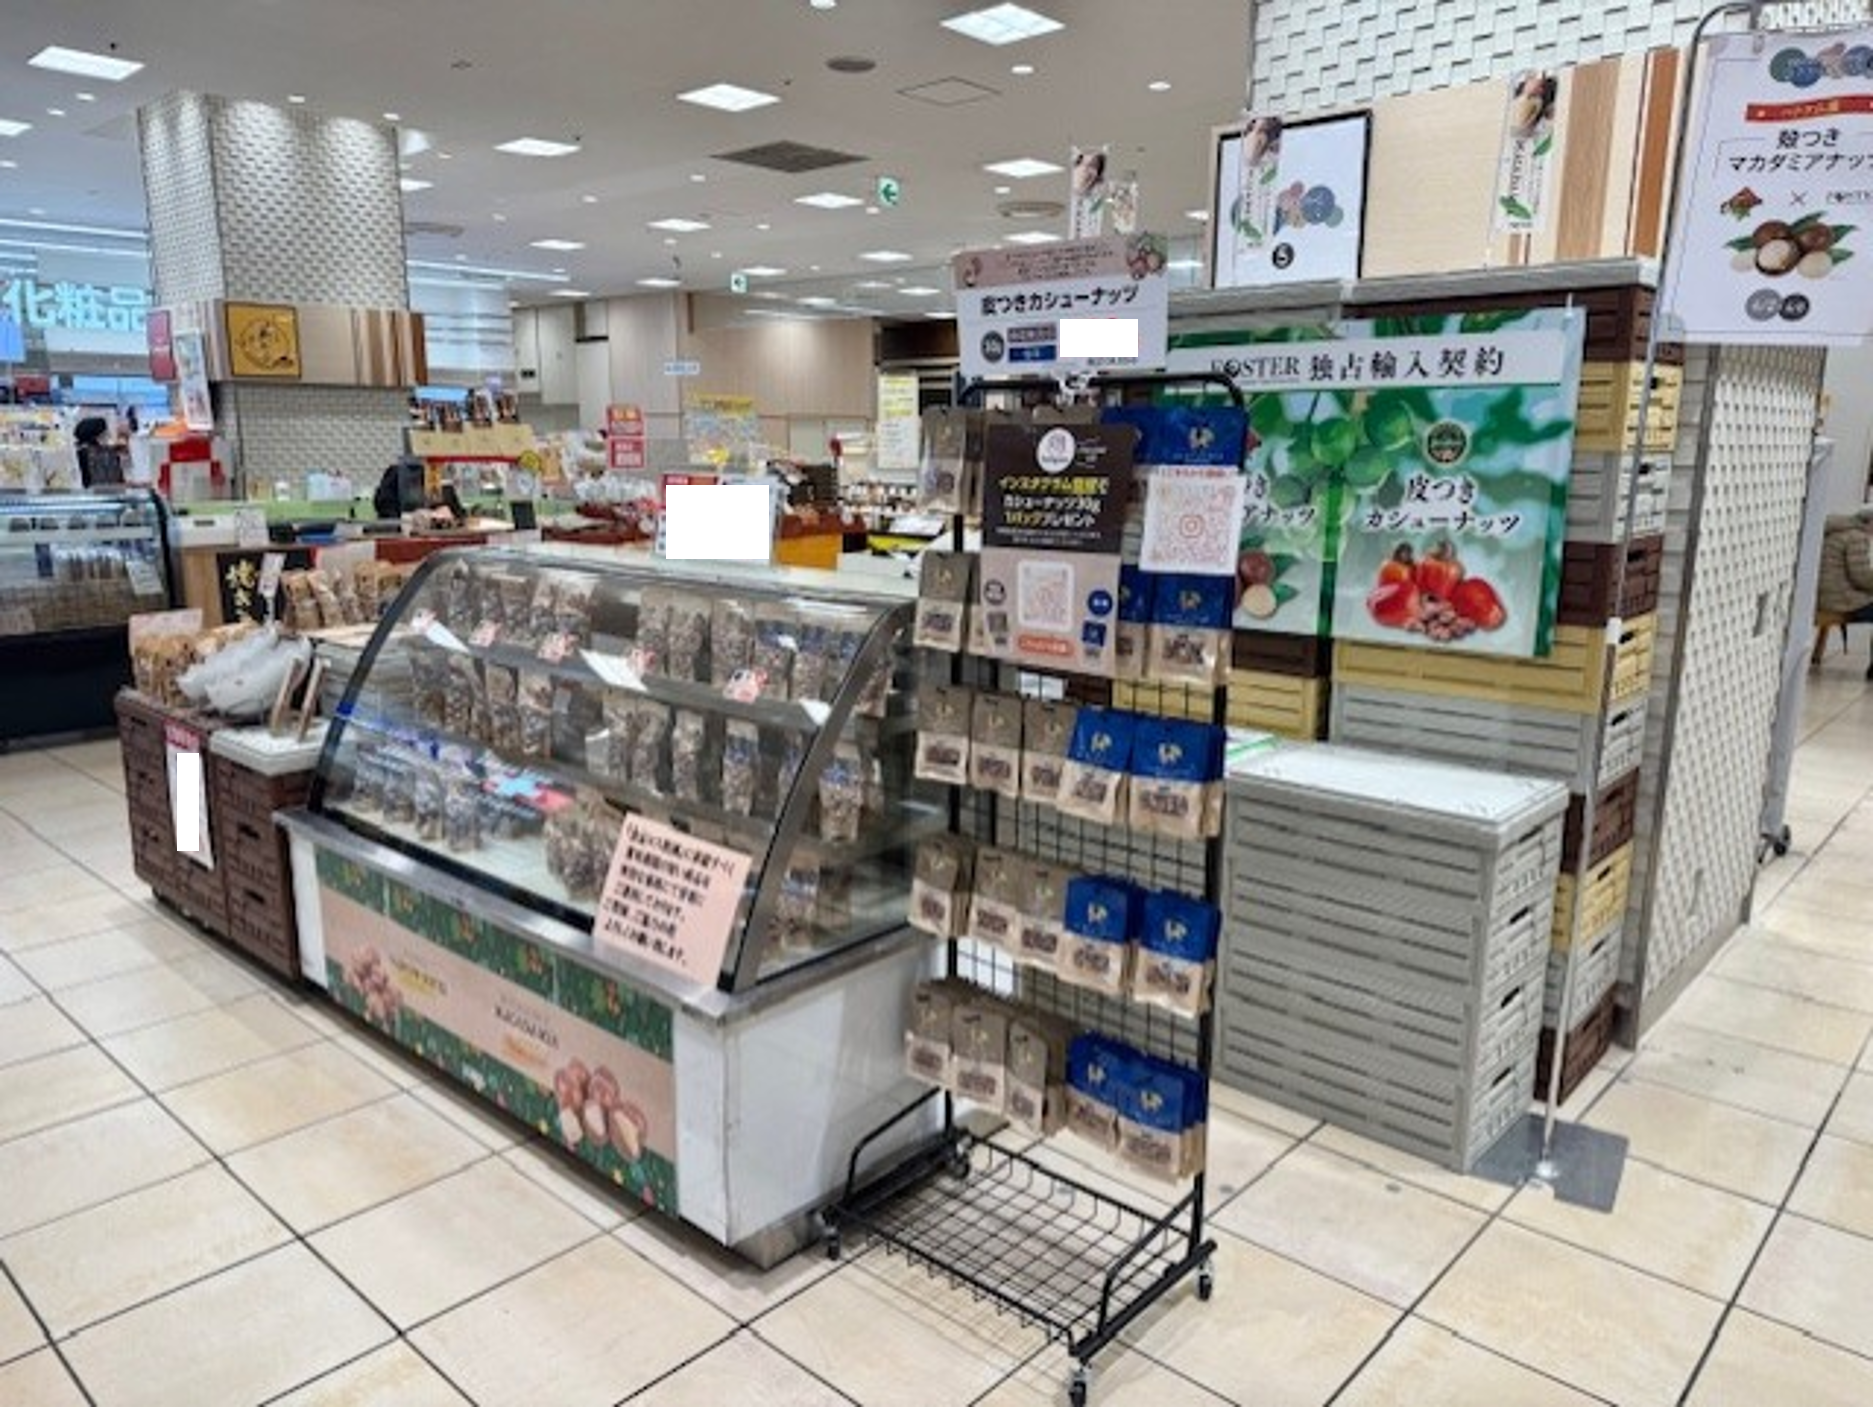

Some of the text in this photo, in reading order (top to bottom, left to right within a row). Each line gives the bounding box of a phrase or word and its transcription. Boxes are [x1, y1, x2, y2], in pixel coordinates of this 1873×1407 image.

[1776, 128, 1839, 149] 殻つき
[2, 279, 148, 332] 化粧品
[981, 284, 1139, 316] 皮つきカシューナッツ
[1210, 345, 1505, 381] FOSTER 独占輸入契約
[1406, 474, 1474, 503] 皮つき
[1366, 510, 1520, 533] カシューナッツ
